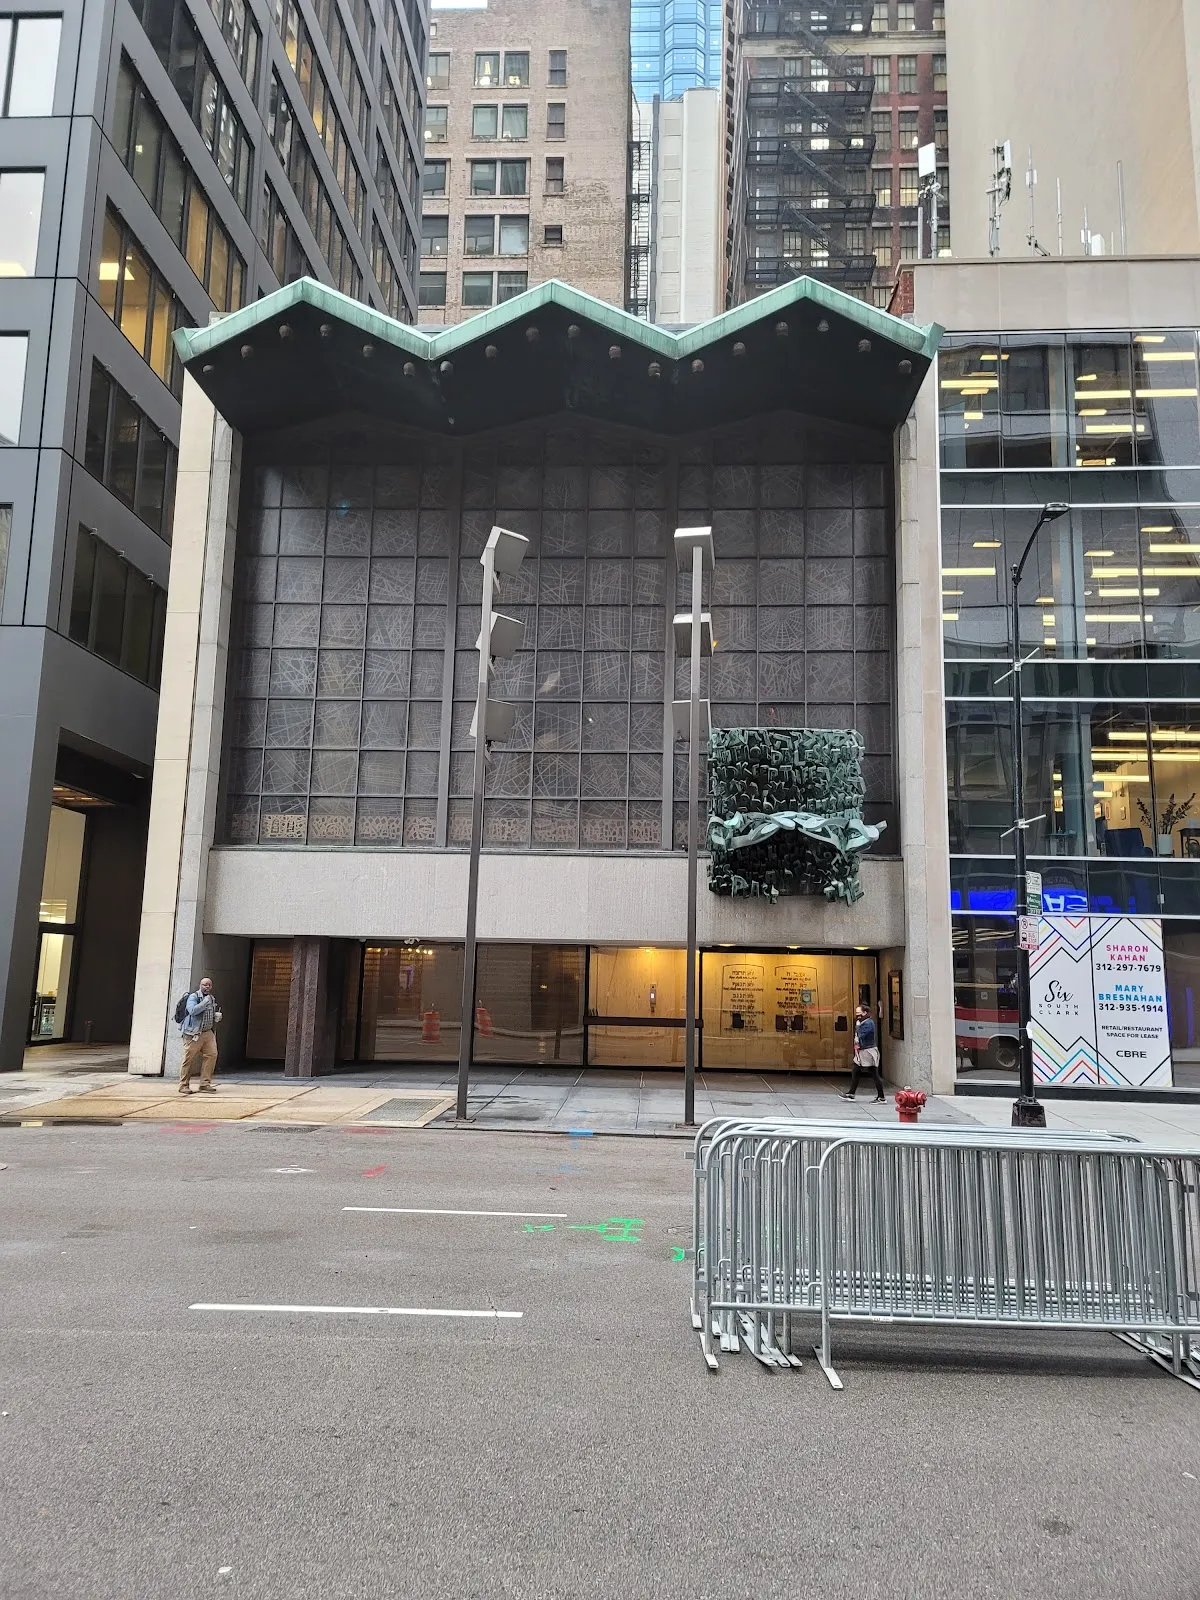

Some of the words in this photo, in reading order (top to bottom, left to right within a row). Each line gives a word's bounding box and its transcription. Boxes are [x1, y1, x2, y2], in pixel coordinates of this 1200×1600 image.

[1106, 944, 1149, 952] SHARON
[1095, 963, 1161, 972] 312-297-7679
[1044, 980, 1074, 1003] Six
[1115, 984, 1144, 992] MARY
[1098, 993, 1162, 1002] BRESNAHAN
[1098, 1003, 1164, 1012] 312-935-1914
[1116, 1050, 1148, 1059] CBRE
